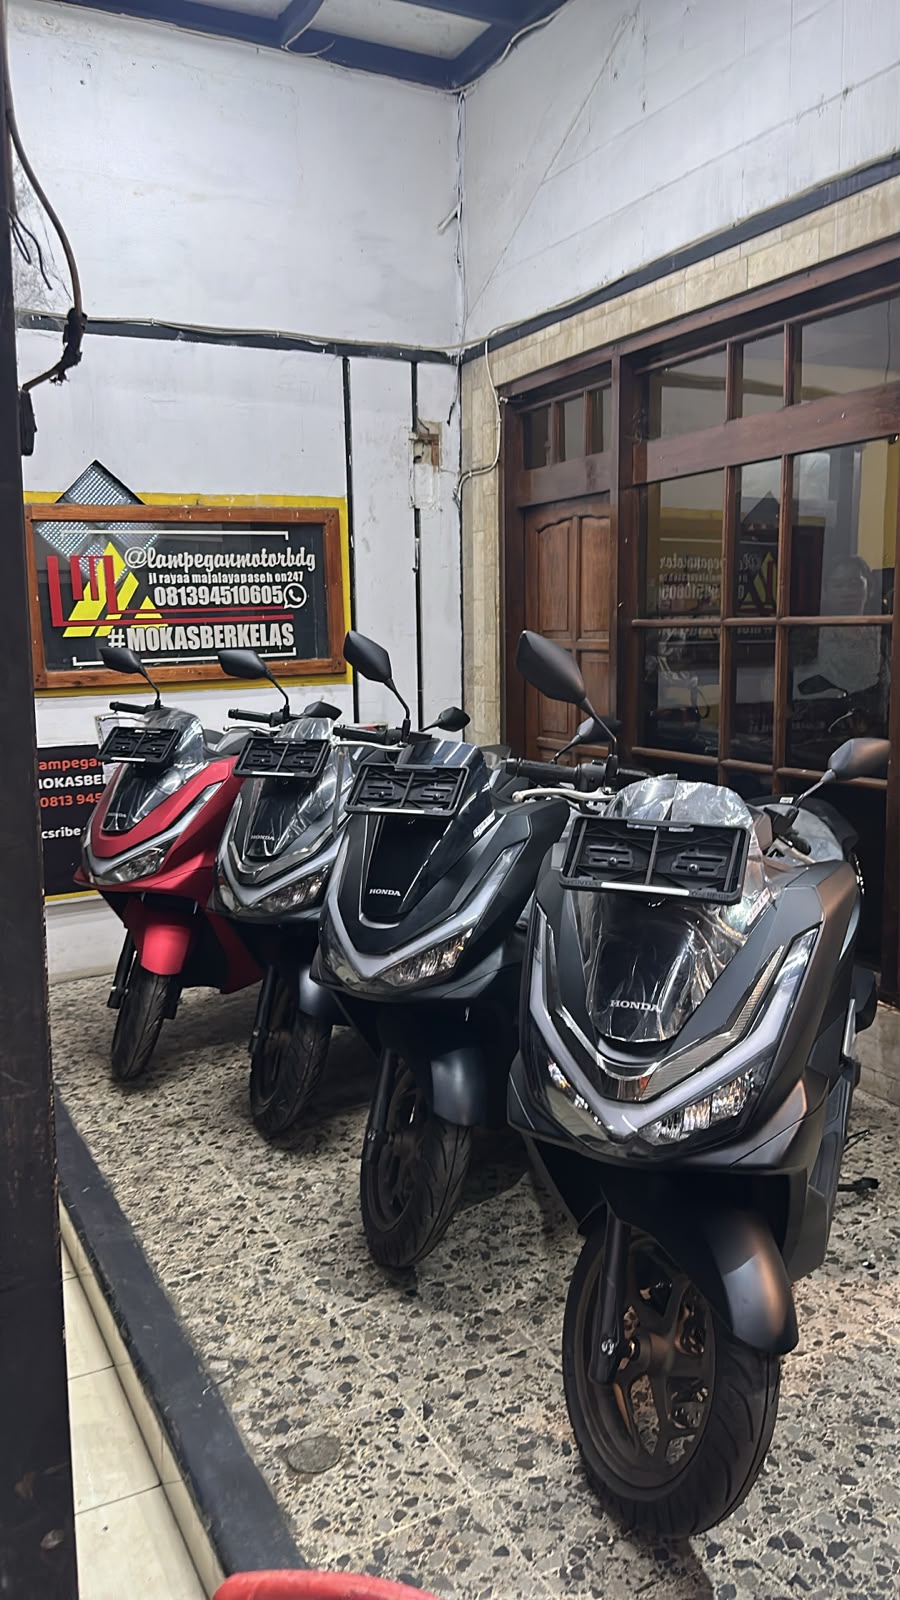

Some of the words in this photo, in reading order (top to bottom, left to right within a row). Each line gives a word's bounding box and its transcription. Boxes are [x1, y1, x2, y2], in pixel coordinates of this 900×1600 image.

[124, 546, 316, 573] @lampeganmotorbdg
[154, 585, 283, 607] 081394510605
[107, 623, 294, 651] #MOKASBERKELAS
[38, 758, 102, 772] ampega
[40, 795, 73, 808] 0813
[369, 888, 401, 897] HONDA
[609, 999, 661, 1013] HONDA
